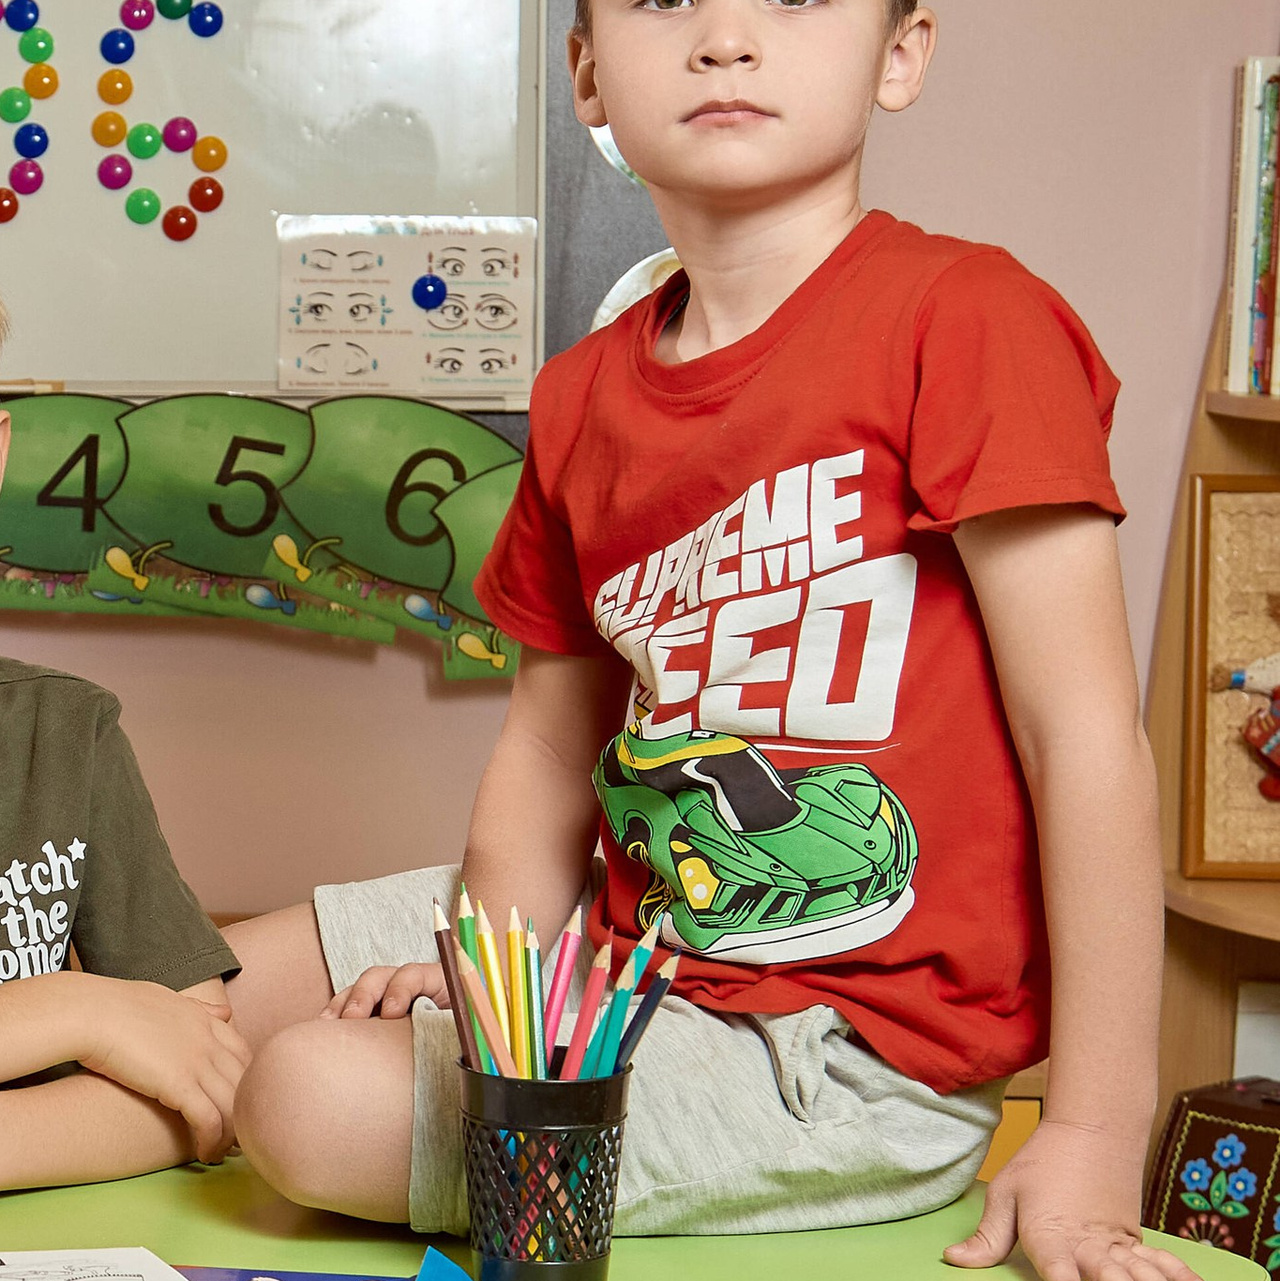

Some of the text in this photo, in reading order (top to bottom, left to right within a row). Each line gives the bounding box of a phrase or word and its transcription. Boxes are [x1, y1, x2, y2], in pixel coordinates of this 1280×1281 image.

[35, 433, 104, 533] 4
[207, 435, 288, 537] 5
[386, 448, 467, 547] 6
[593, 448, 865, 642] SUPREME
[0, 895, 69, 948] the
